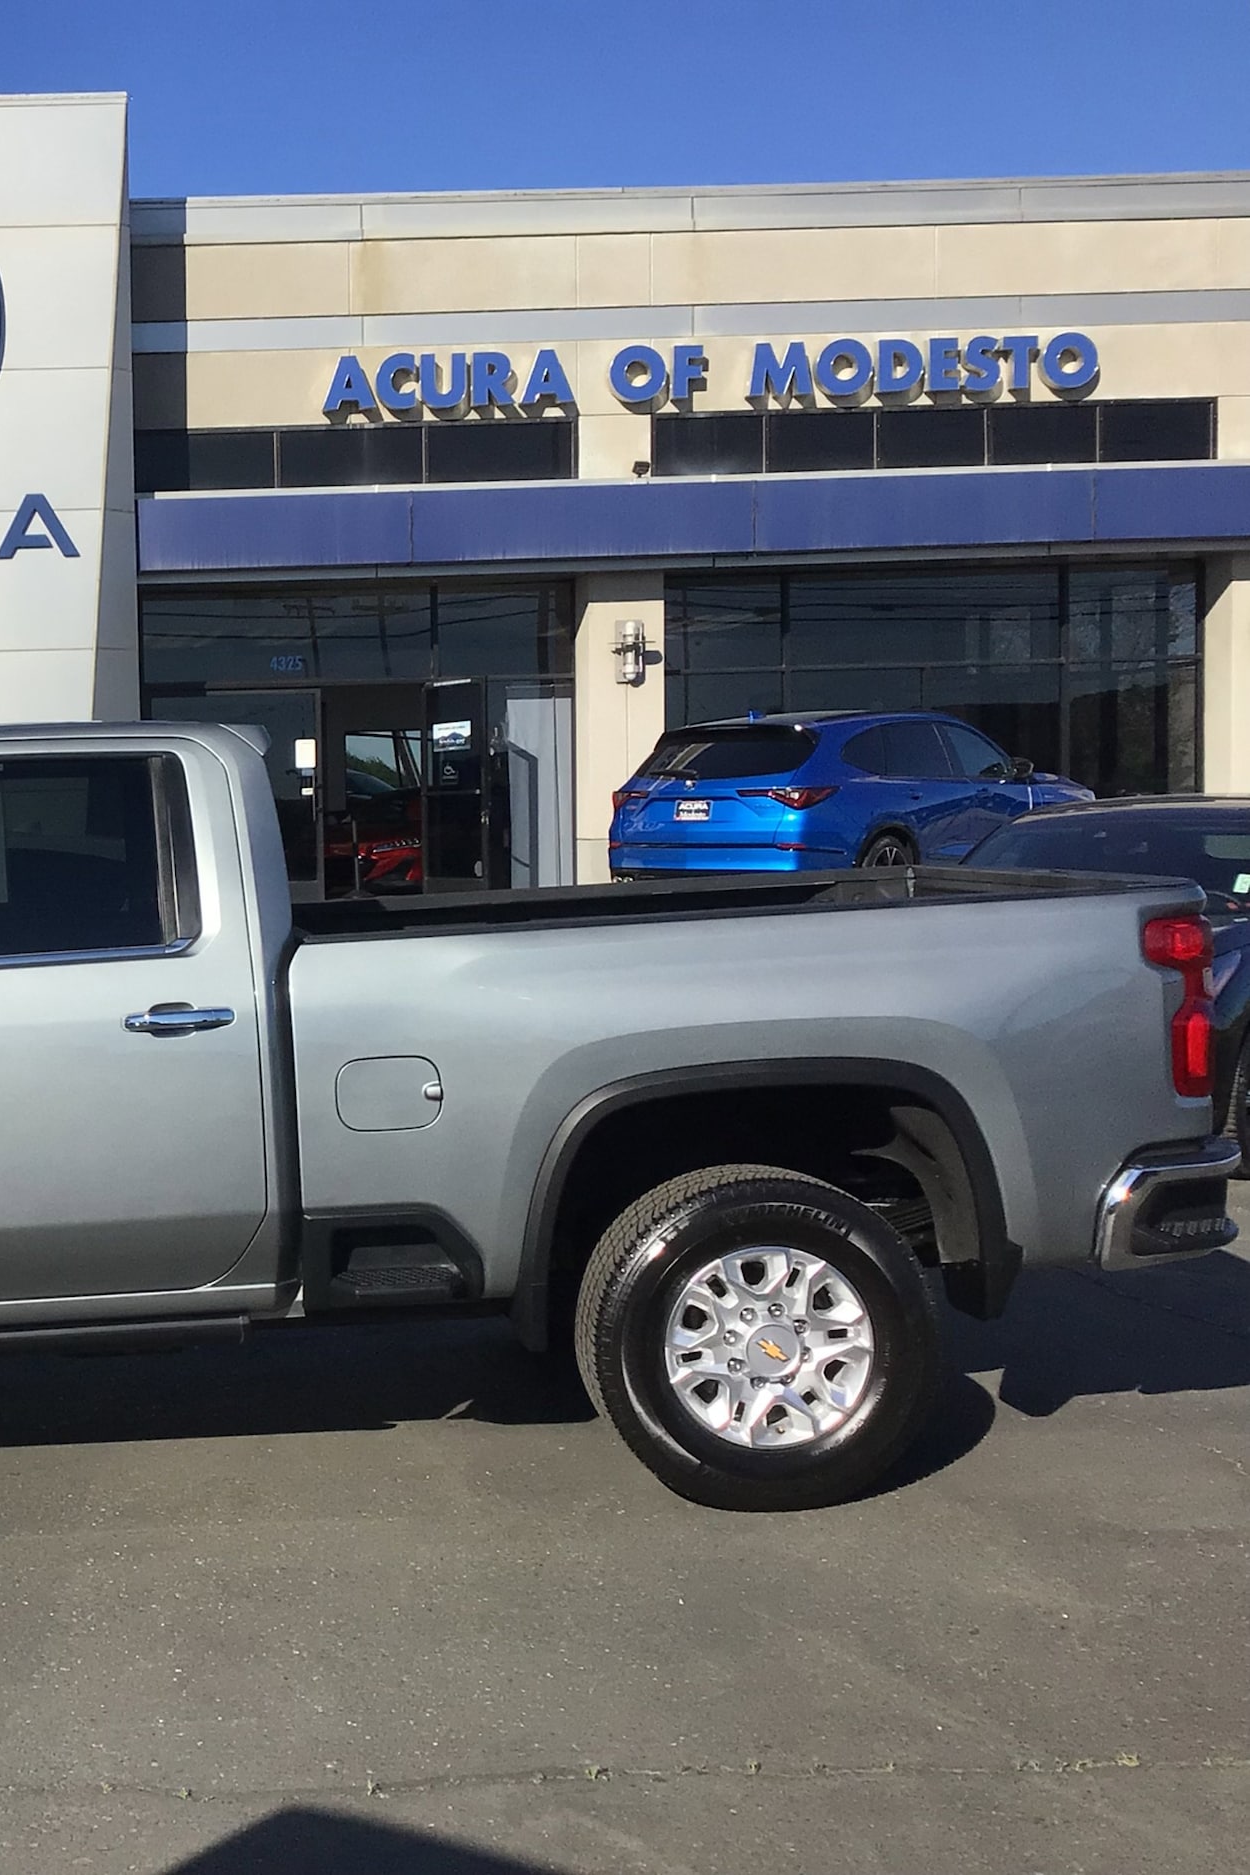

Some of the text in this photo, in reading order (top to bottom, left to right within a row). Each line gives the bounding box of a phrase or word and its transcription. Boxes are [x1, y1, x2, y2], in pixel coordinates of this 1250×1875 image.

[324, 331, 1100, 413] ACURA OF MODESTO
[270, 655, 303, 671] 4325
[678, 802, 709, 810] ACURA
[747, 1204, 852, 1238] MICHELIN
